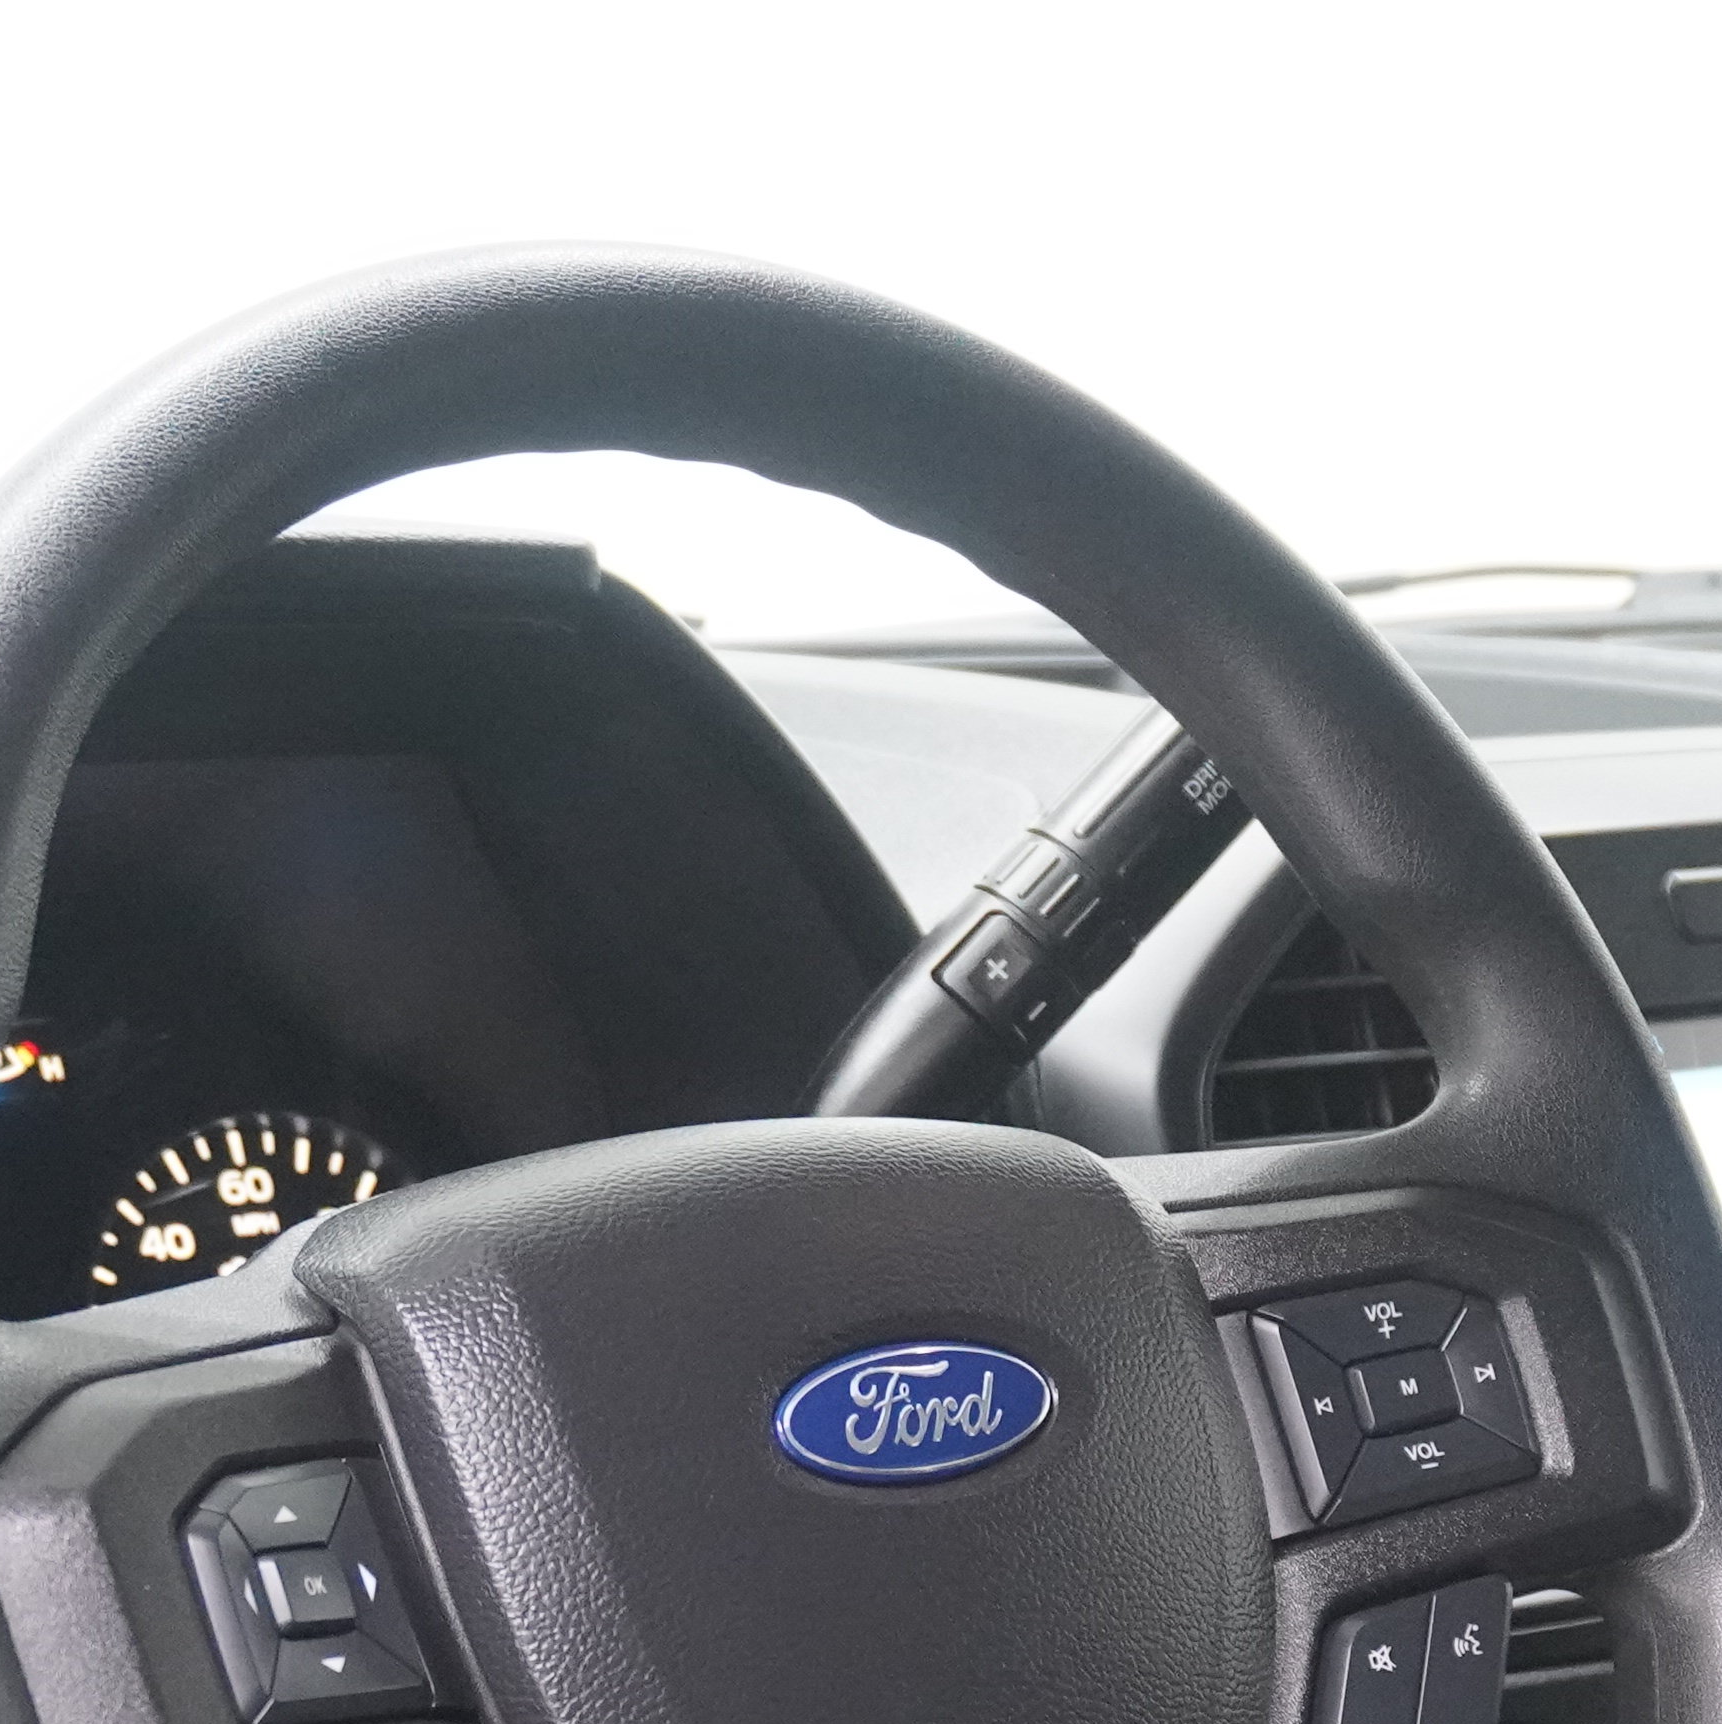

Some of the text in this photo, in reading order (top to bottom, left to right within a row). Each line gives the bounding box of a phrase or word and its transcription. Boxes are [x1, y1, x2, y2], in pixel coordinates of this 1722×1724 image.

[1182, 759, 1215, 799] DRI
[38, 1055, 65, 1083] H
[217, 1166, 275, 1207] 60
[139, 1222, 197, 1262] 40
[1363, 1301, 1404, 1323] VOL
[1399, 1378, 1419, 1397] M
[845, 1359, 1003, 1455] Ford
[1403, 1441, 1446, 1462] VOL
[303, 1575, 328, 1596] OK
